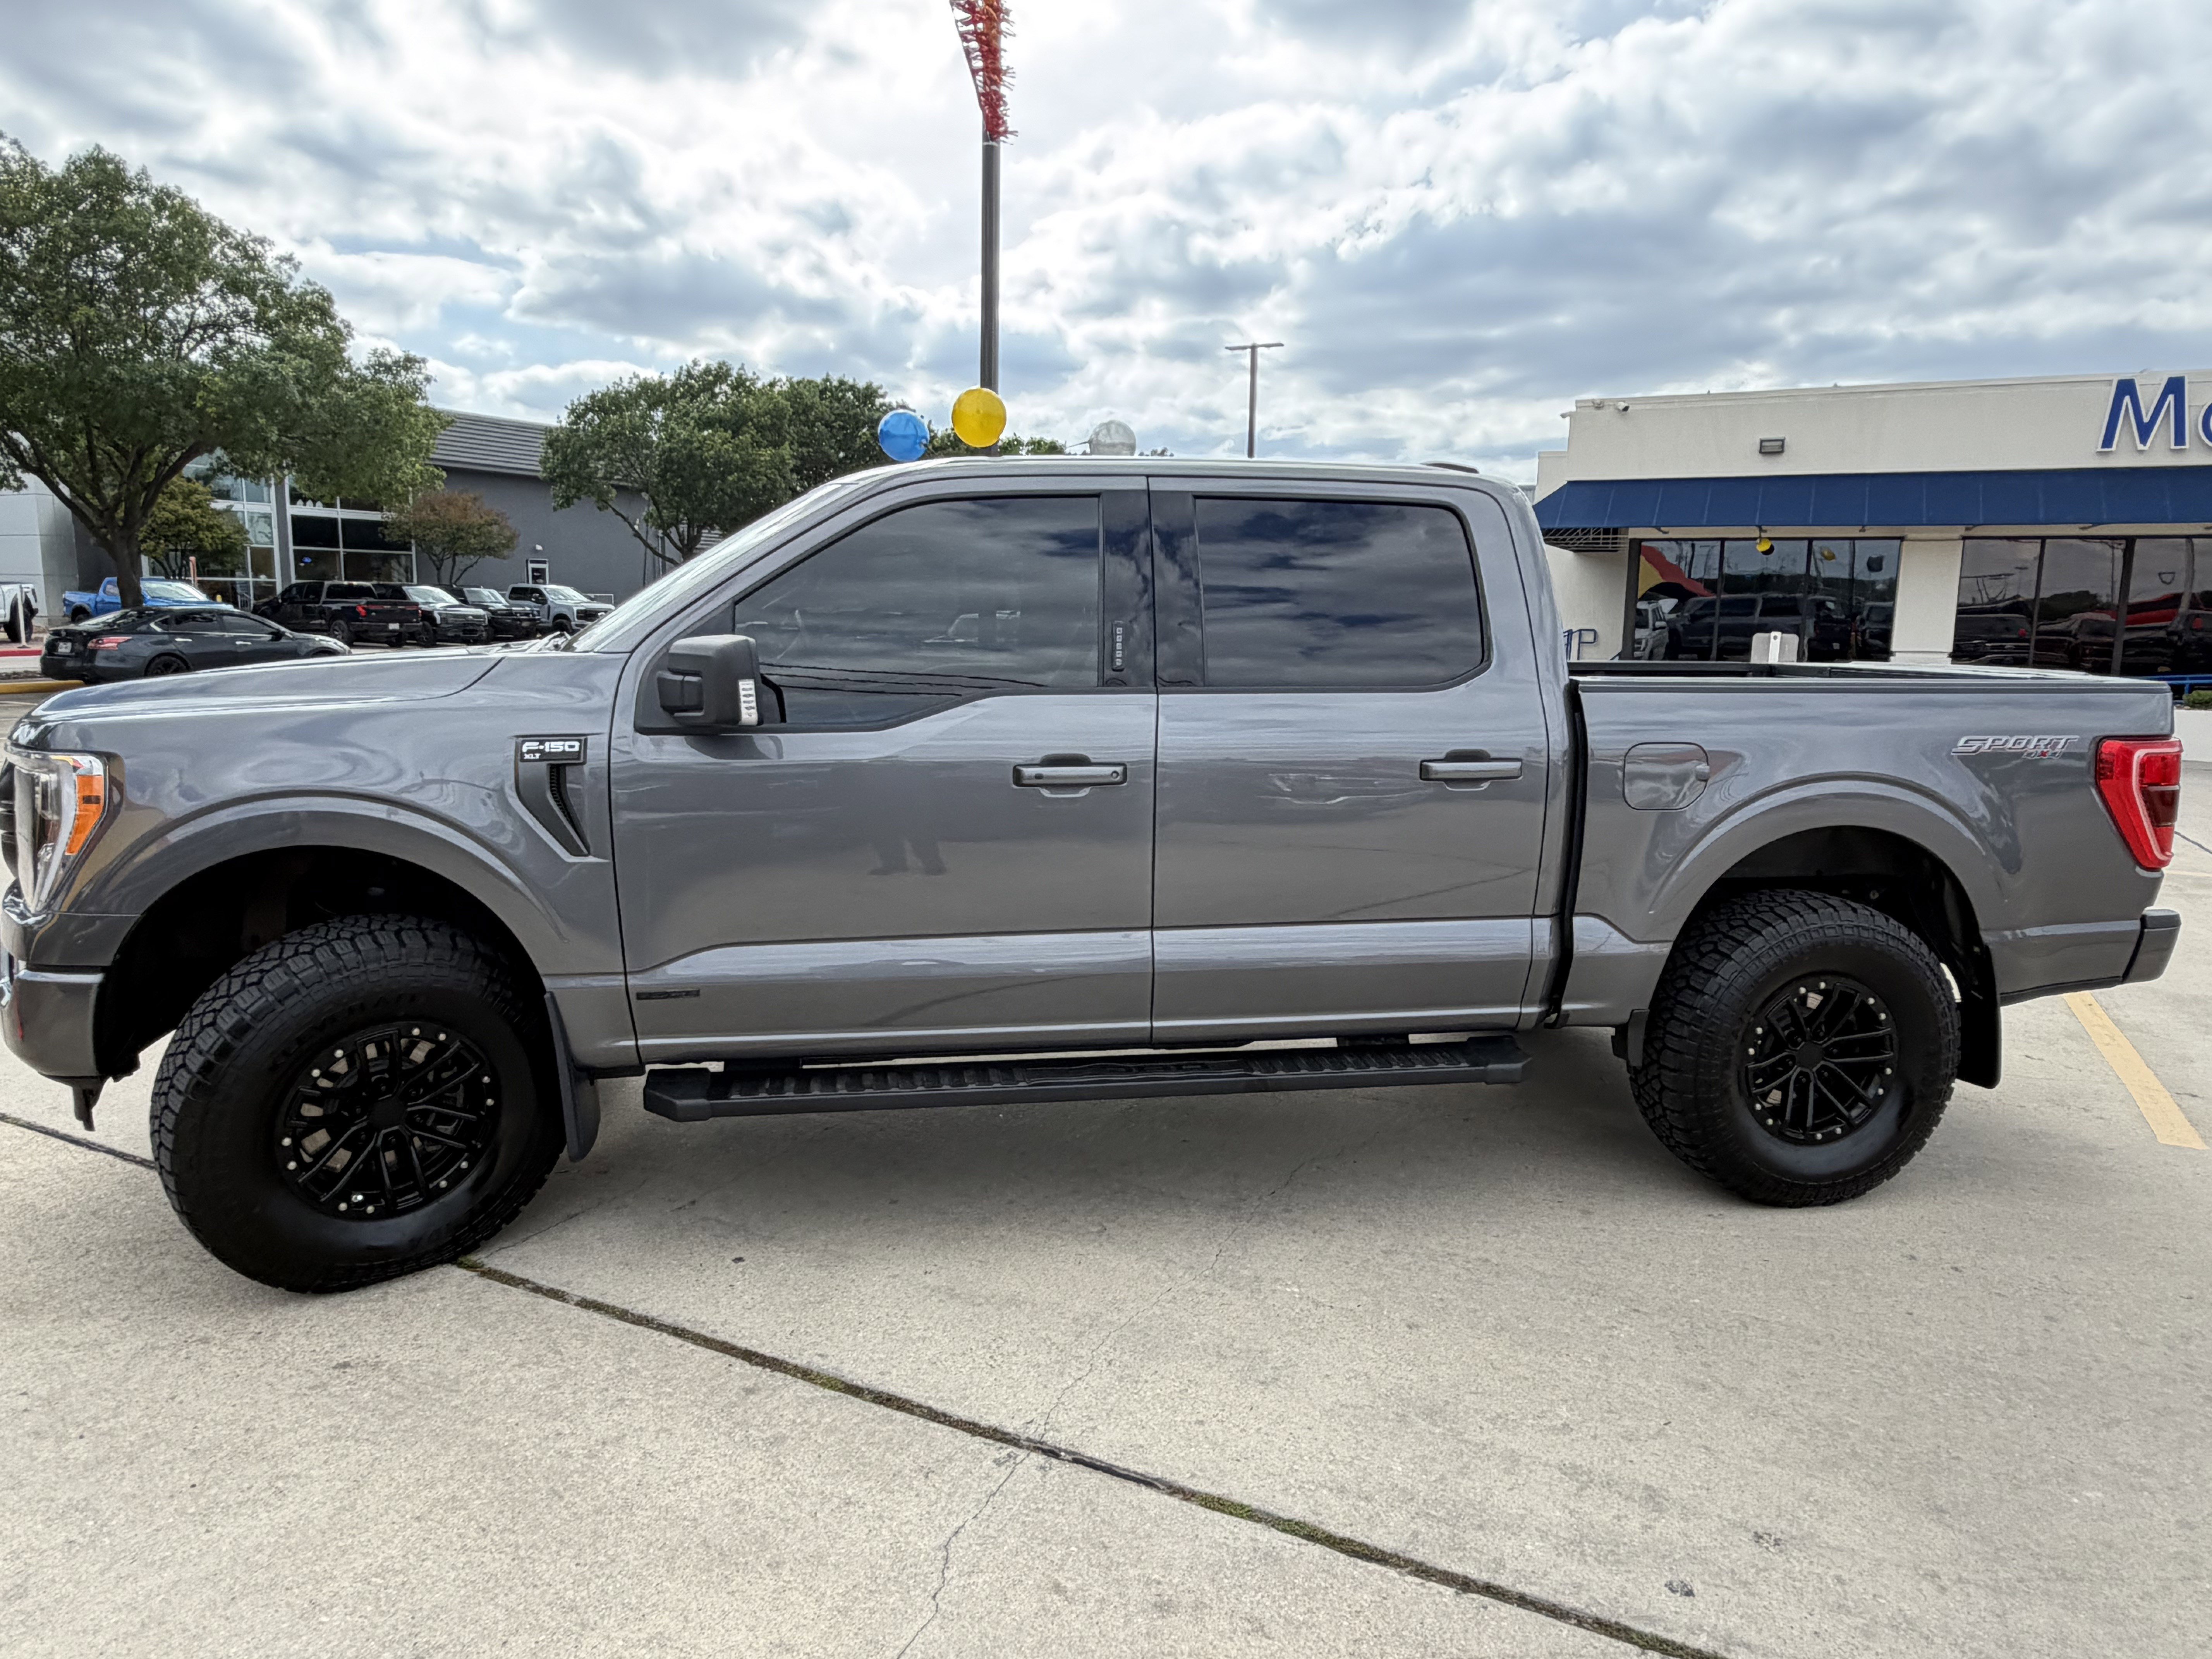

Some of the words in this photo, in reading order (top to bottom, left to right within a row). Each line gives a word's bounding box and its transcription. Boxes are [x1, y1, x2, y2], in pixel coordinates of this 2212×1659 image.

[2097, 376, 2212, 451] M
[522, 741, 580, 752] F-150
[1951, 735, 2080, 755] SPORT
